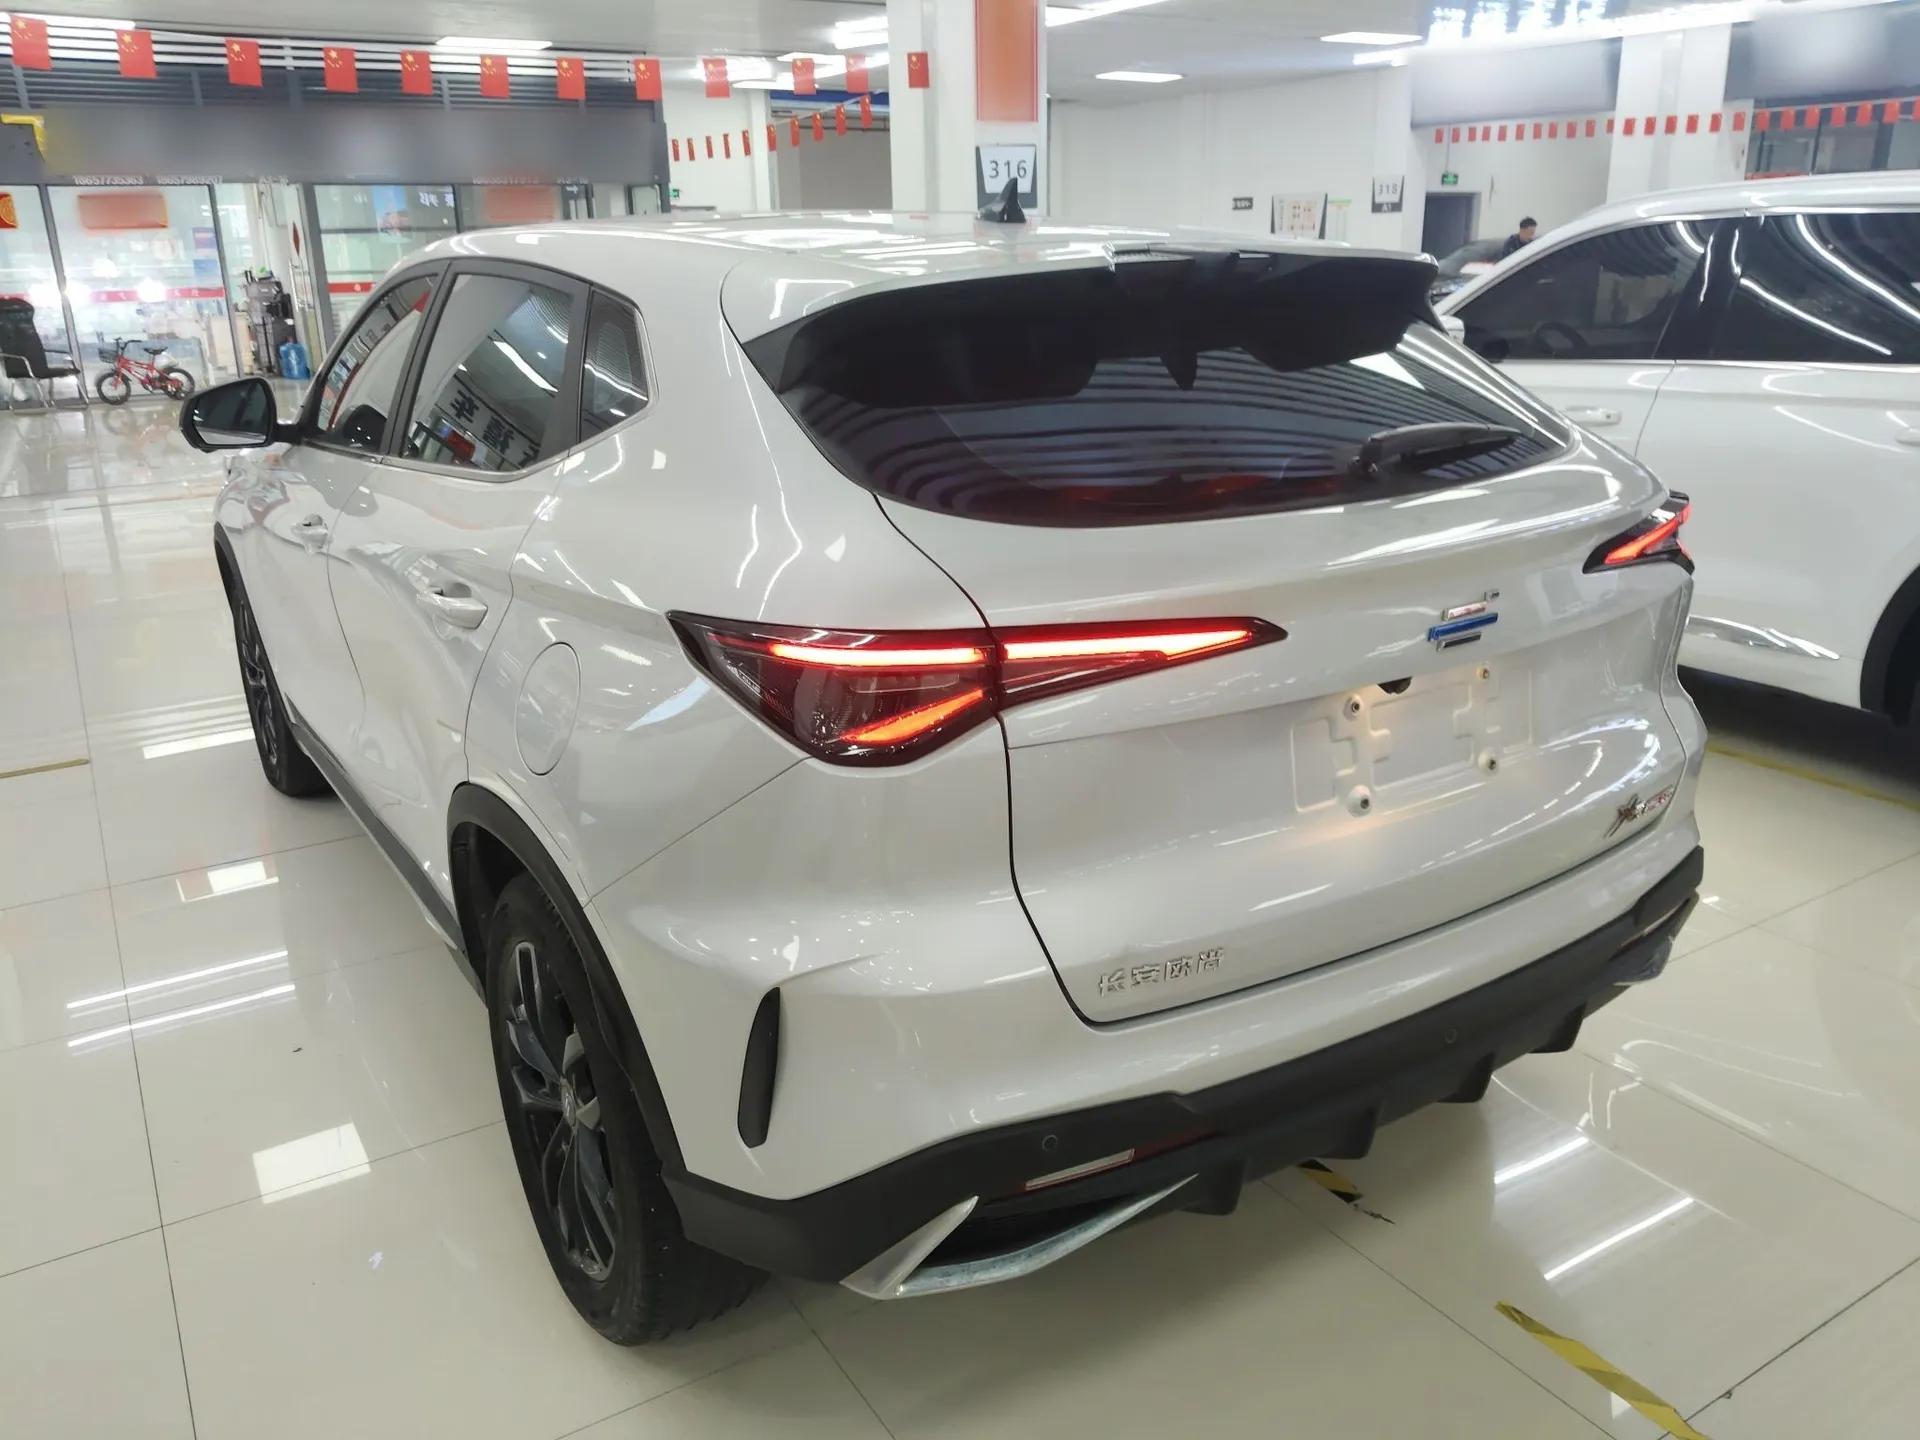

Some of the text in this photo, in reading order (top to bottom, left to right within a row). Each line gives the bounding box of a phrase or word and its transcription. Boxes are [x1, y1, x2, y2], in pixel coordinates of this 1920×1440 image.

[988, 159, 1027, 179] 316
[1098, 947, 1225, 998] 长安欧尚
